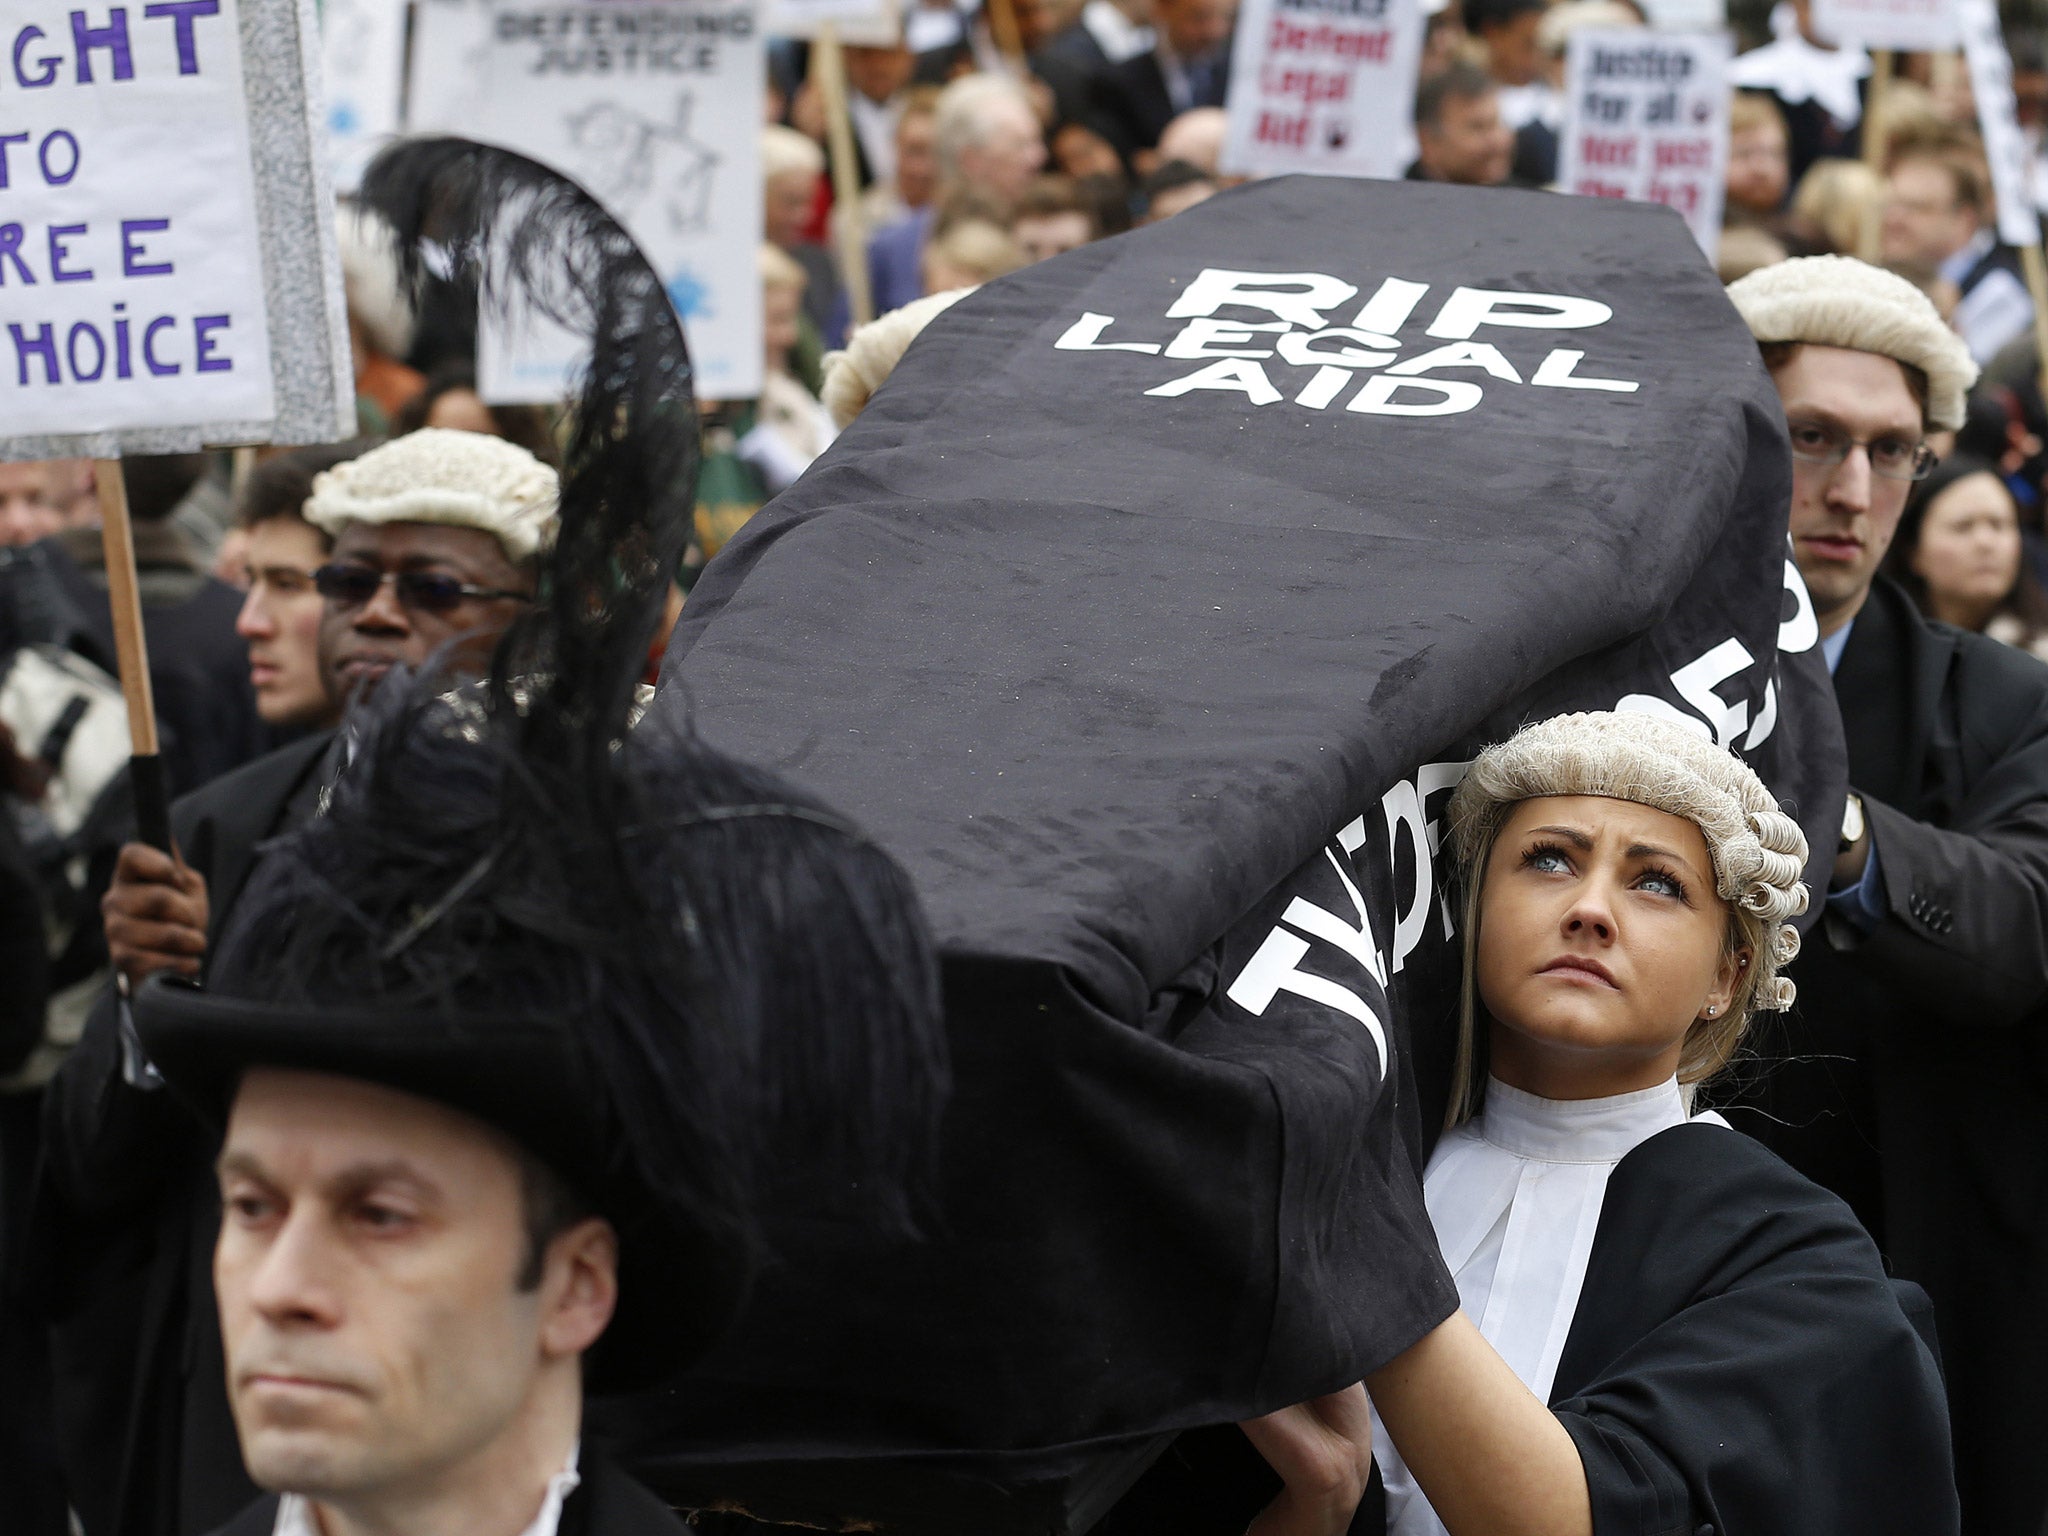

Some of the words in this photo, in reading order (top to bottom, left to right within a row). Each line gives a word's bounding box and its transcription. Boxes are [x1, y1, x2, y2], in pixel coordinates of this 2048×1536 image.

[13, 0, 220, 88] GHT
[495, 9, 757, 41] DEFENDING
[529, 44, 719, 76] JUSTICE
[1165, 268, 1613, 340] RIP
[1054, 312, 1640, 393] LEGAL
[1143, 357, 1484, 417] AID
